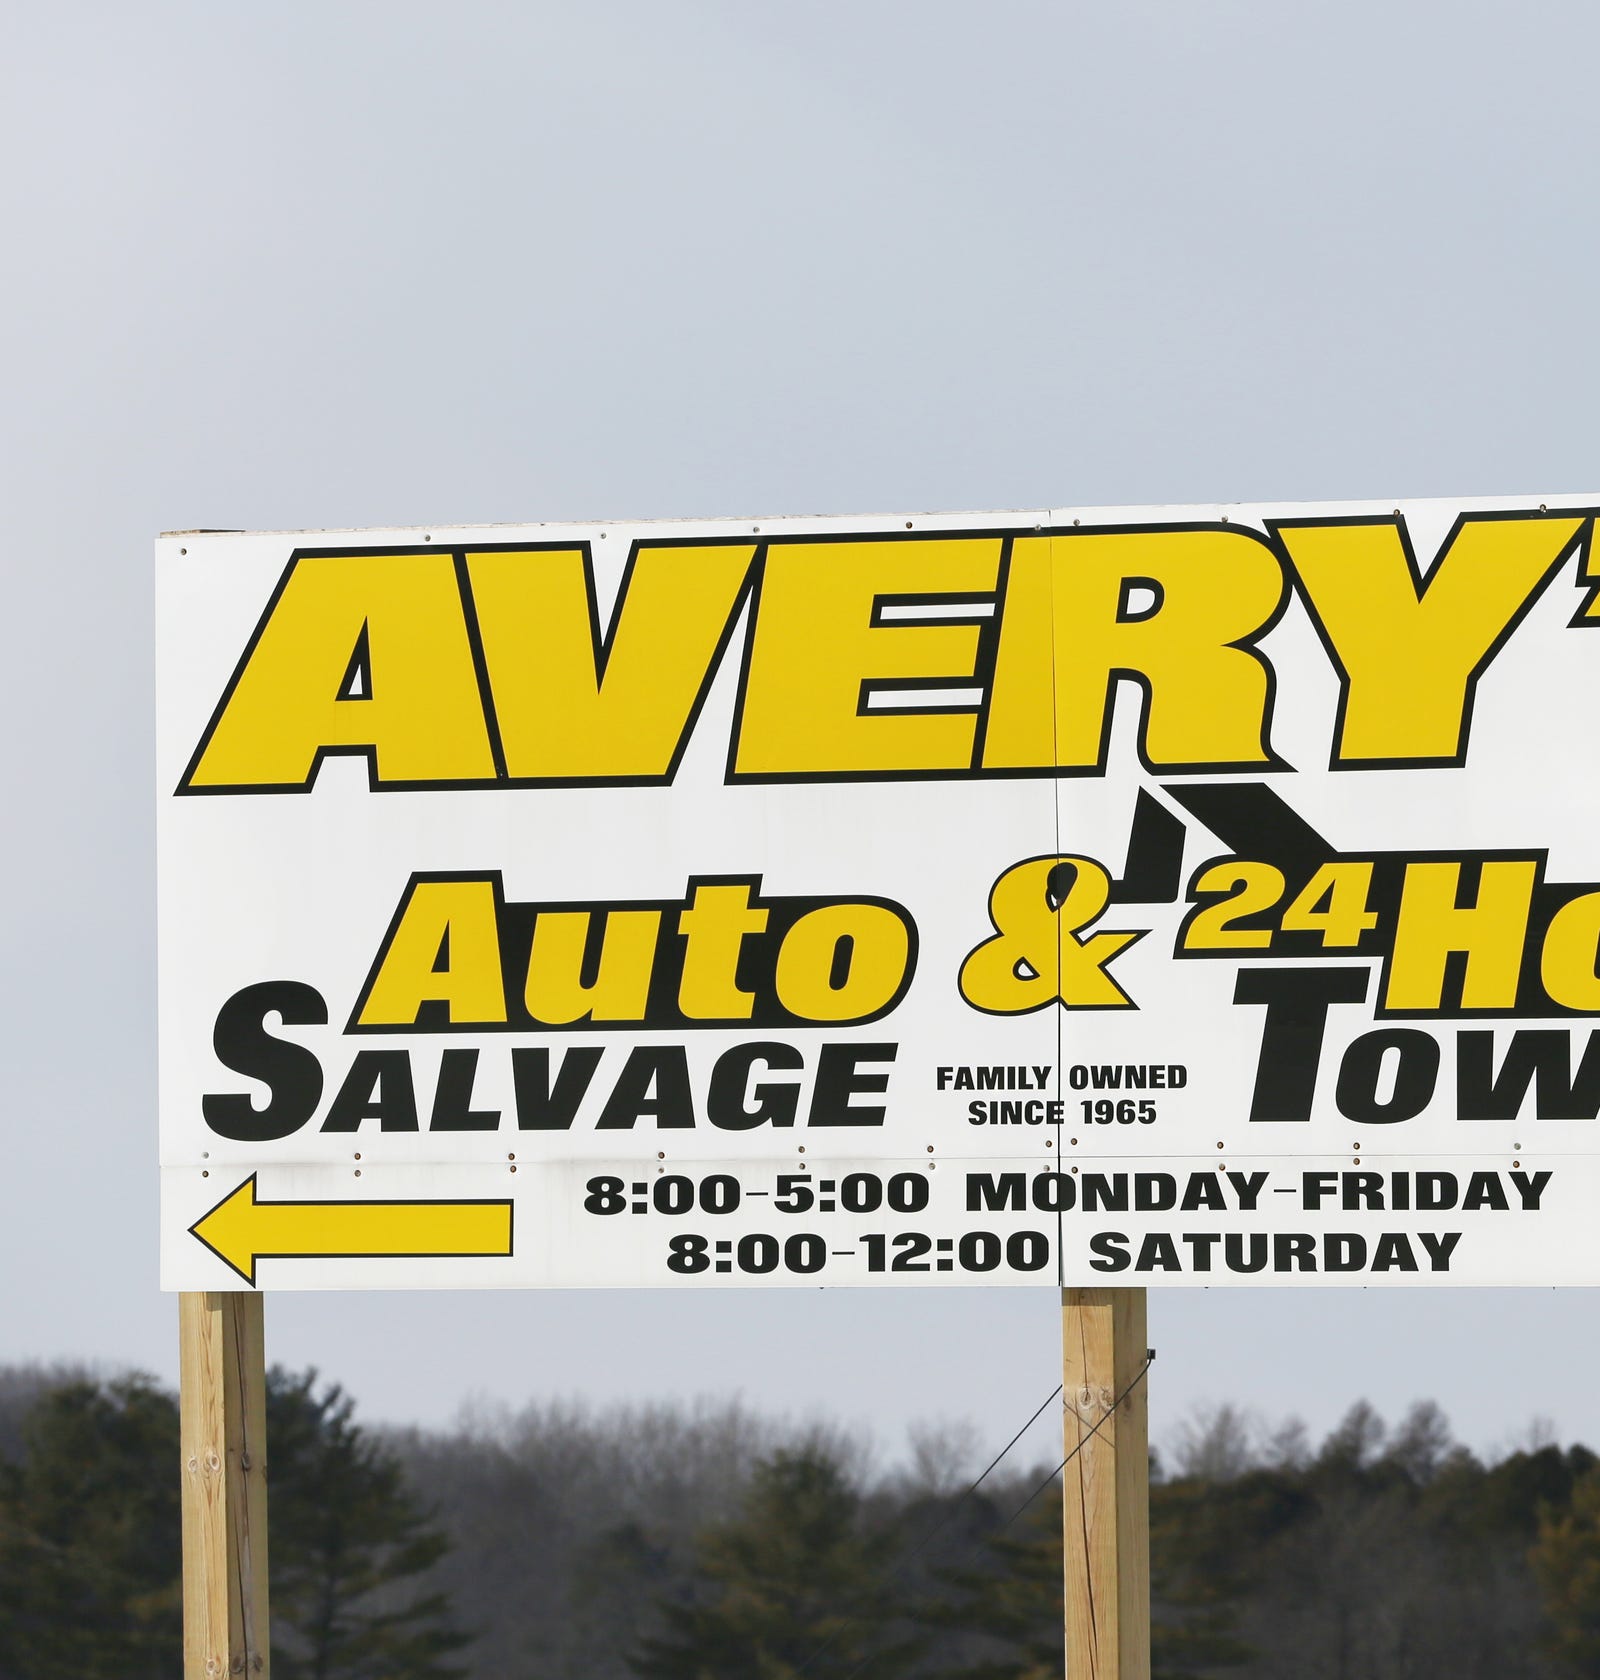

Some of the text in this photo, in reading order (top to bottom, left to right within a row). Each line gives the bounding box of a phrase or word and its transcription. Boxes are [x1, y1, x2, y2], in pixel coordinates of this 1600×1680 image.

[343, 869, 920, 1036] Auto
[957, 853, 1152, 1018] &
[1174, 852, 1382, 959] 24
[201, 980, 899, 1142] SALVAGE
[936, 1064, 1188, 1091] FAMILY OWNED
[968, 1099, 1157, 1126] SINCE 1965
[583, 1171, 1554, 1216] 8:00-5:00 MONDAY-FRIDAY
[666, 1231, 1463, 1274] 8:00-12:00 SATURDAY
